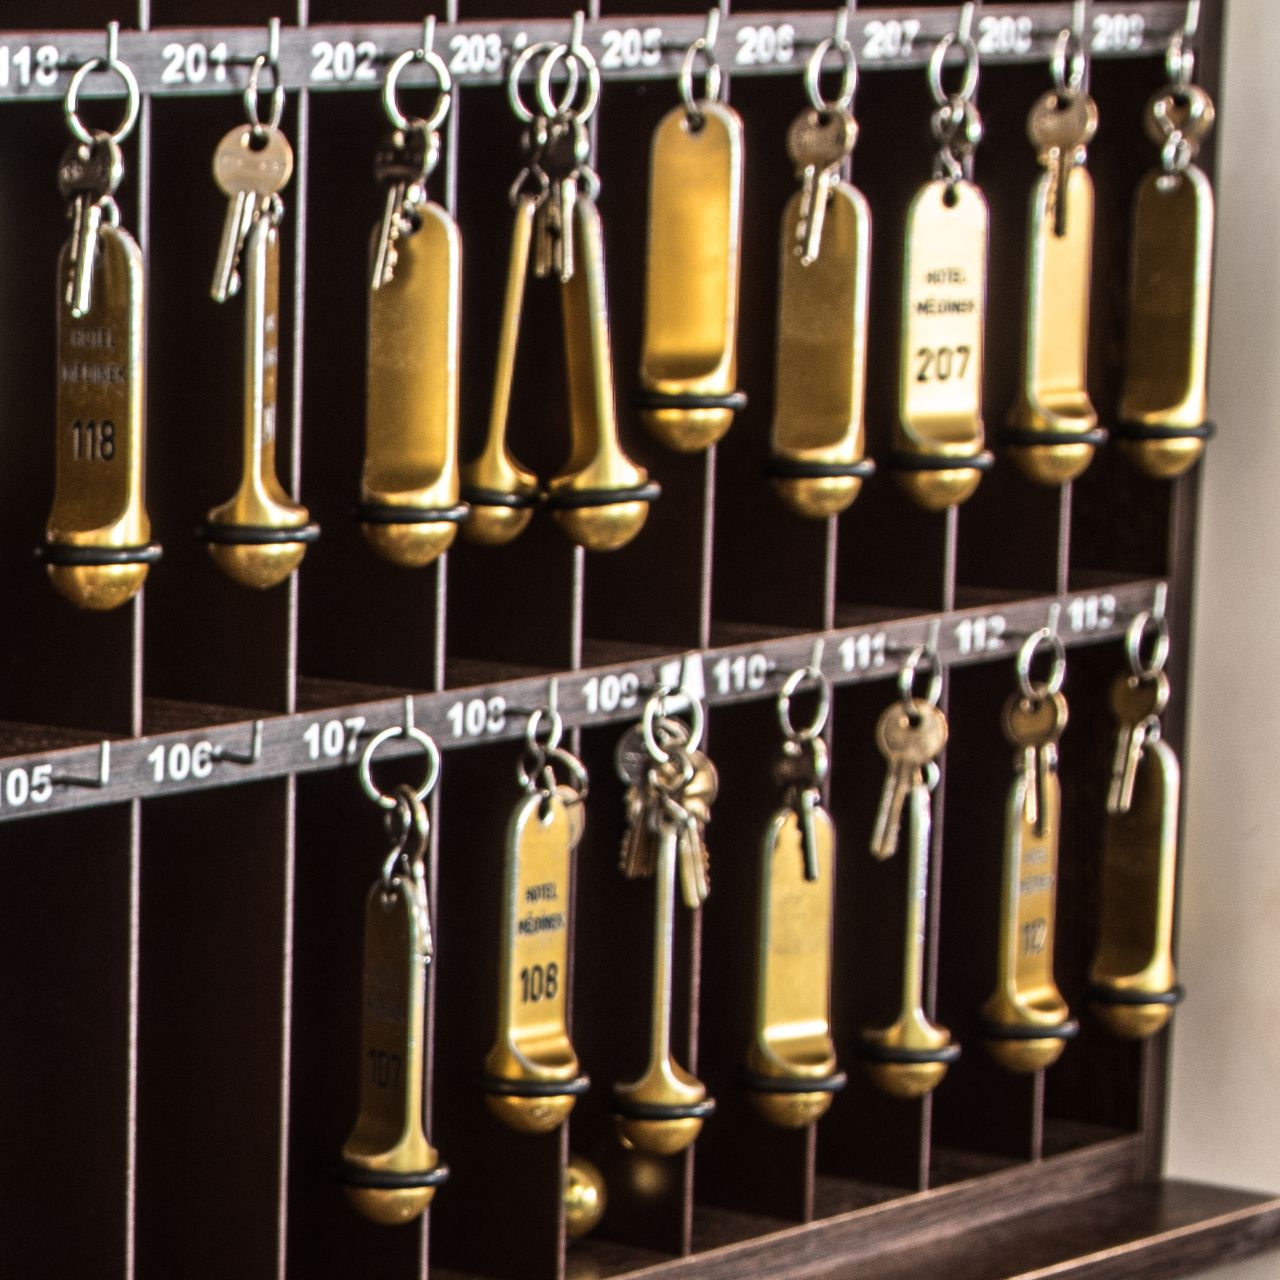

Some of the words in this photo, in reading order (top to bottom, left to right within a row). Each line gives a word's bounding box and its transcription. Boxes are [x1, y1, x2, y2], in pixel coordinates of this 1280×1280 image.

[601, 28, 662, 69] 205
[735, 24, 794, 65] 206
[863, 19, 920, 58] 207
[161, 42, 227, 84] 201
[310, 40, 377, 80] 202
[915, 346, 971, 383] 207
[72, 419, 116, 462] 118
[581, 673, 640, 715] 109
[713, 654, 768, 696] 110
[447, 695, 507, 738] 108
[303, 716, 366, 761] 107
[148, 741, 213, 783] 106
[519, 960, 560, 1005] 108
